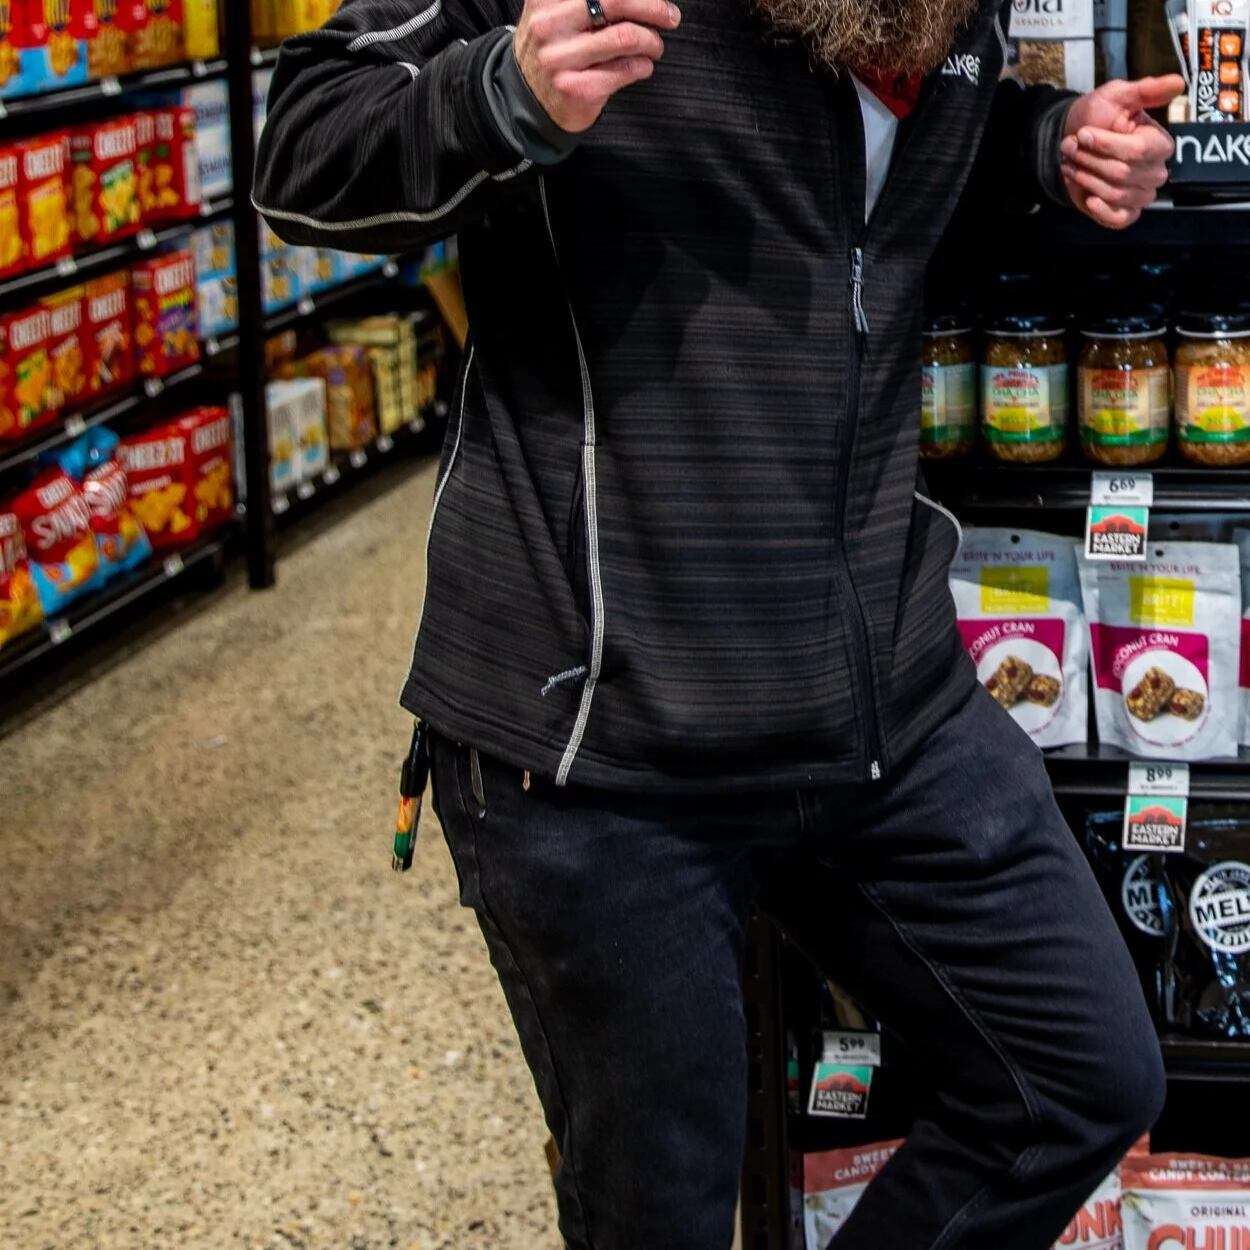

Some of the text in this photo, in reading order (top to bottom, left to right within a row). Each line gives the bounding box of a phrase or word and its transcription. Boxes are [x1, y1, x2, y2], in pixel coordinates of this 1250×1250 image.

[1092, 532, 1140, 544] EASTERN
[1092, 542, 1140, 555] MARKET
[1149, 632, 1179, 647] CRAN
[1130, 823, 1179, 836] EASTERN
[1130, 834, 1178, 845] MARKET
[817, 1090, 863, 1102] EASTERN
[816, 1100, 863, 1112] MARKET
[1190, 1205, 1246, 1218] ORIGINAL
